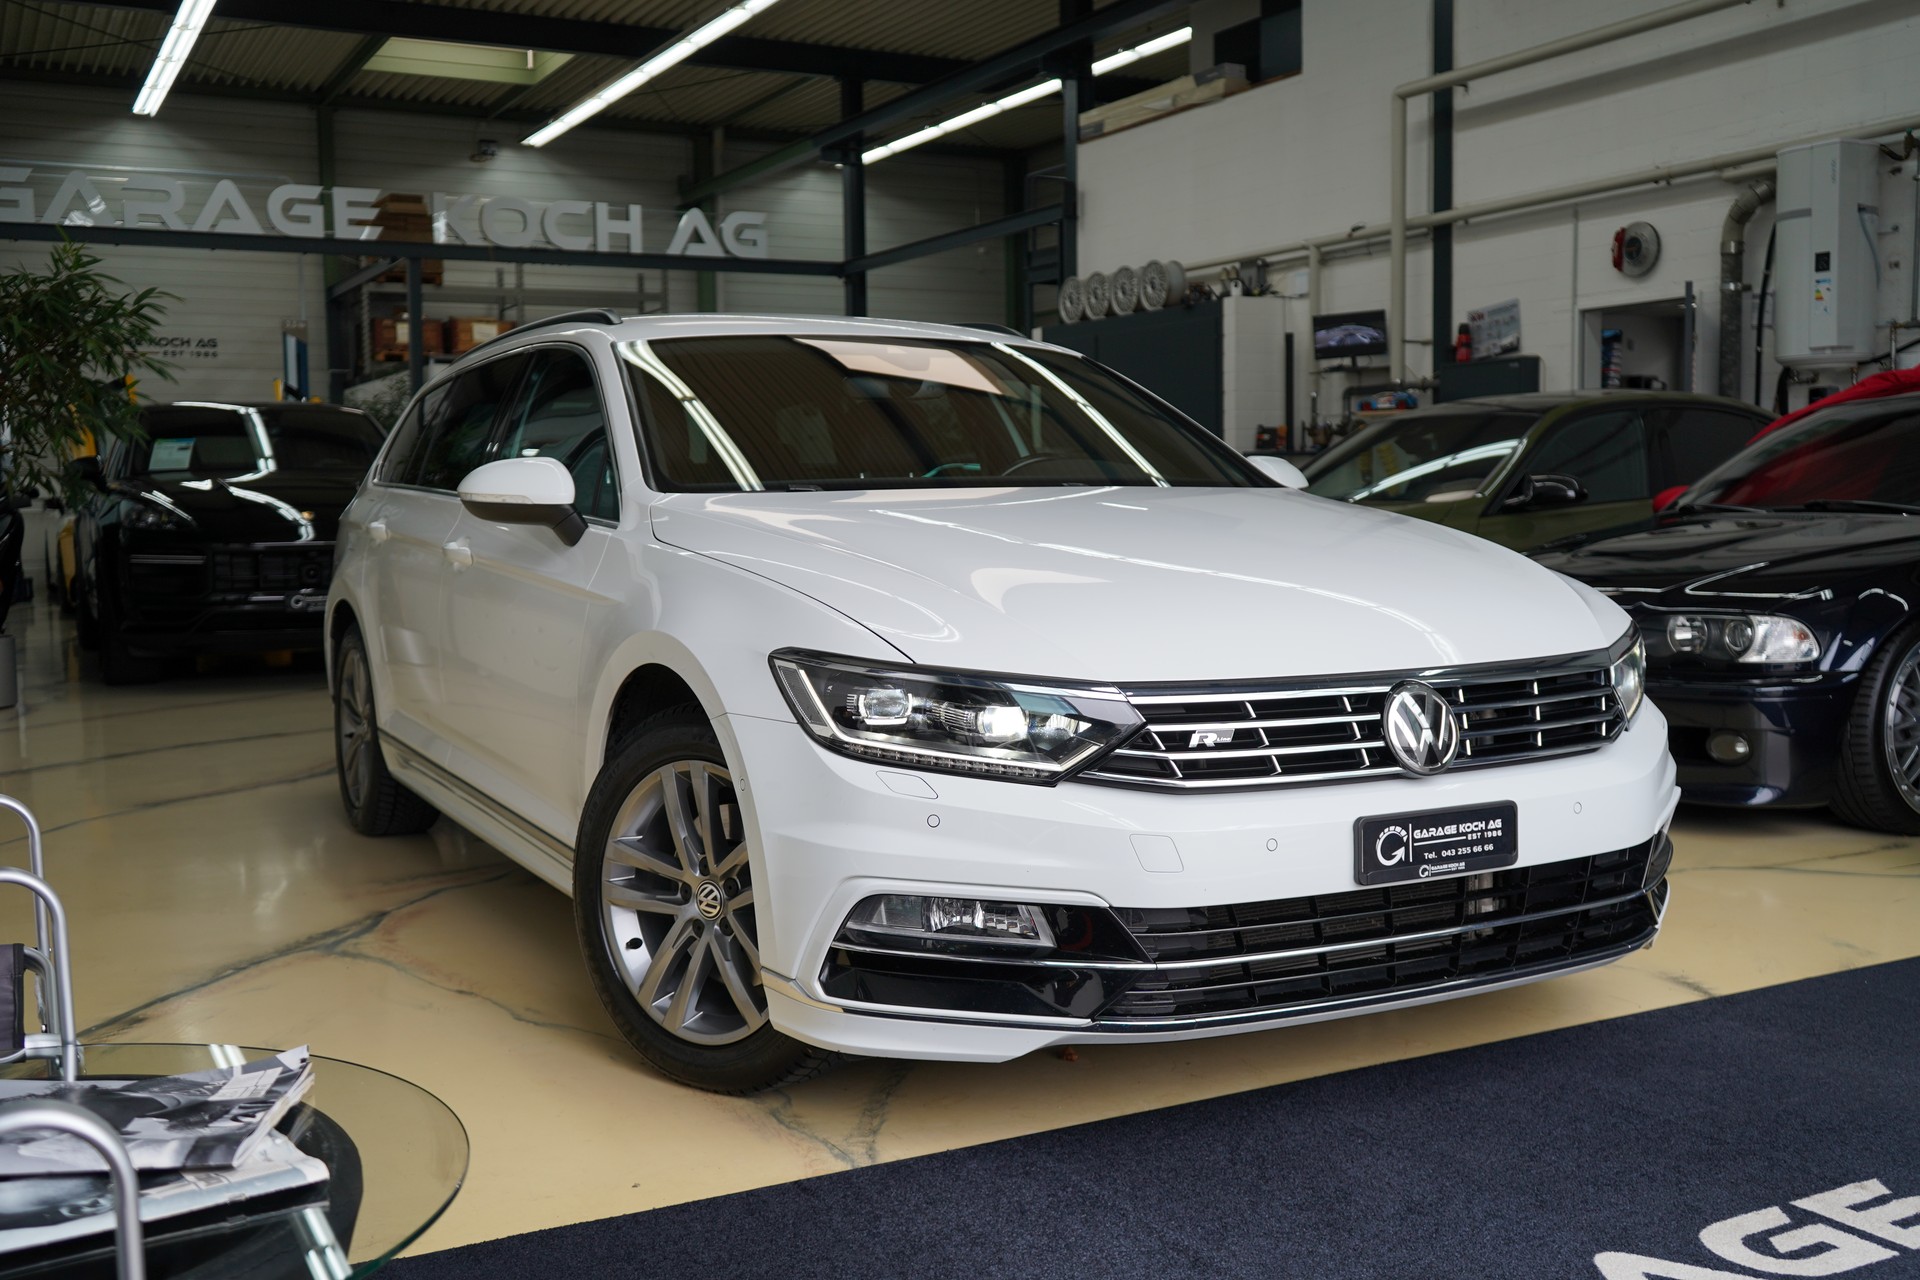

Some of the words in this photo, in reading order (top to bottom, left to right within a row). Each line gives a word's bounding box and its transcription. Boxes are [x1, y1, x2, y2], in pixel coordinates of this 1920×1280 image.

[0, 166, 384, 240] GARAGE
[432, 191, 644, 254] KOCH
[665, 207, 769, 260] AG
[195, 337, 218, 348] AG
[162, 349, 185, 357] EST
[1188, 732, 1218, 748] R
[1413, 824, 1458, 839] GARAGE
[1458, 820, 1486, 832] KOCH
[1487, 818, 1503, 829] AG
[1467, 833, 1482, 841] EST
[1484, 829, 1503, 838] 1986
[1423, 851, 1438, 860] Tel.
[1441, 849, 1456, 858] 043
[1457, 847, 1472, 856] 255
[1472, 845, 1483, 854] 66
[1484, 843, 1494, 852] 66
